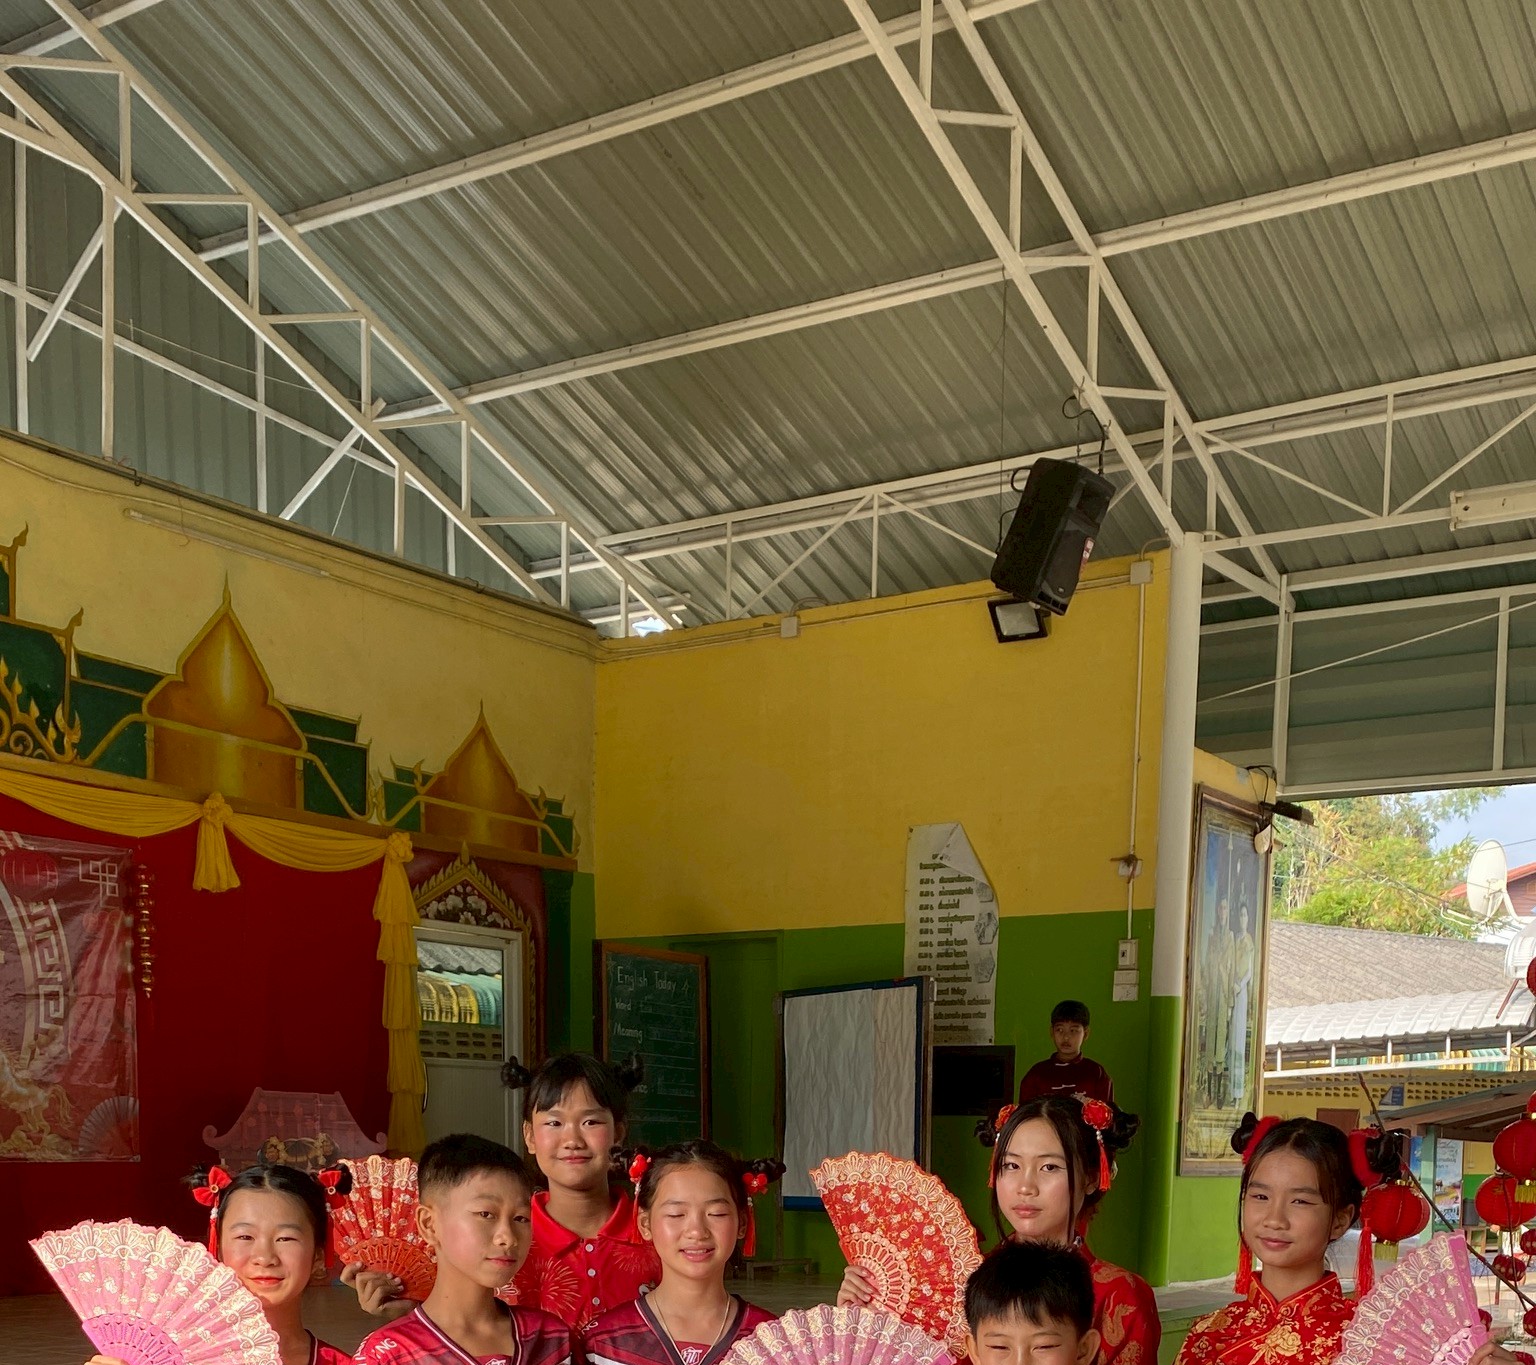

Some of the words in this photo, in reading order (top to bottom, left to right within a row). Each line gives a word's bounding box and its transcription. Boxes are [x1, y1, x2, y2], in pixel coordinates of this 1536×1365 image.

[617, 966, 648, 991] English
[654, 970, 677, 997] Today
[613, 1022, 643, 1044] Meaning
